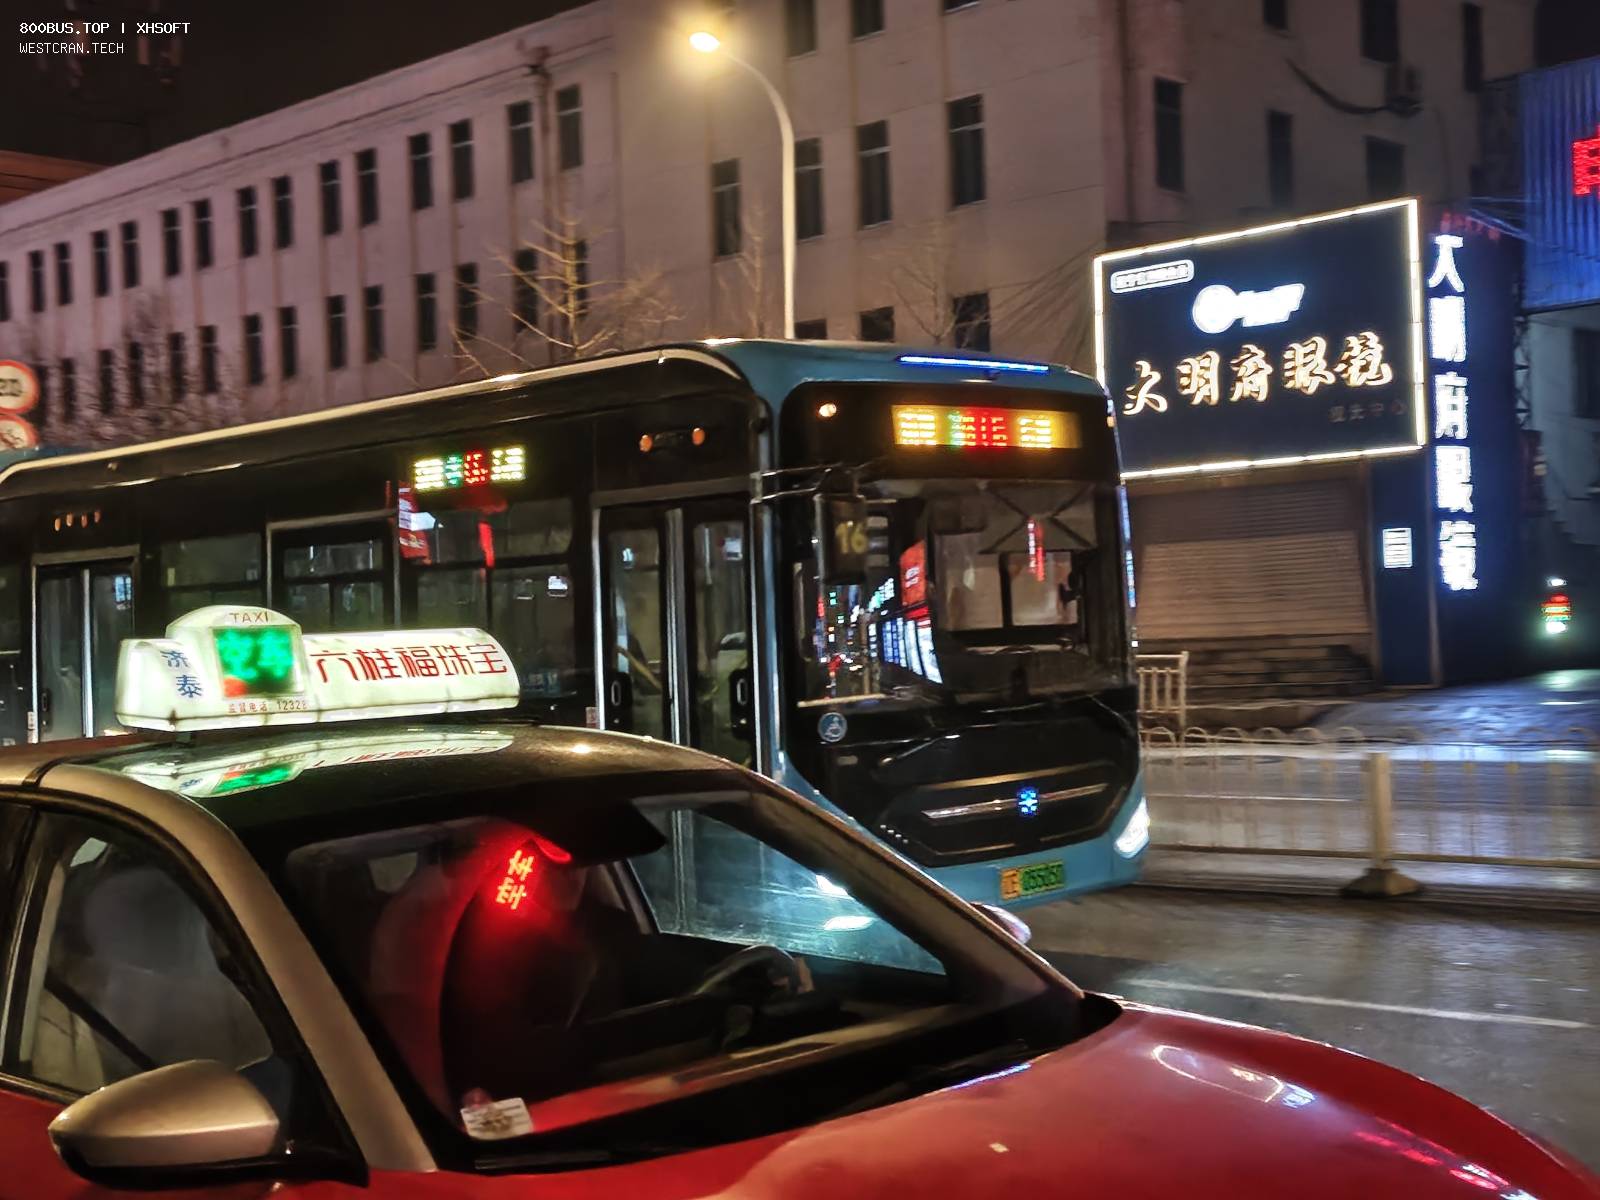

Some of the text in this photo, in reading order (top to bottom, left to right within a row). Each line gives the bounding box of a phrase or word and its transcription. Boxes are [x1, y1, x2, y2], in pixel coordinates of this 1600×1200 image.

[1122, 331, 1393, 416] 大明府眼镜
[229, 612, 269, 622] TAXI
[310, 643, 508, 683] 六桂福珠宝
